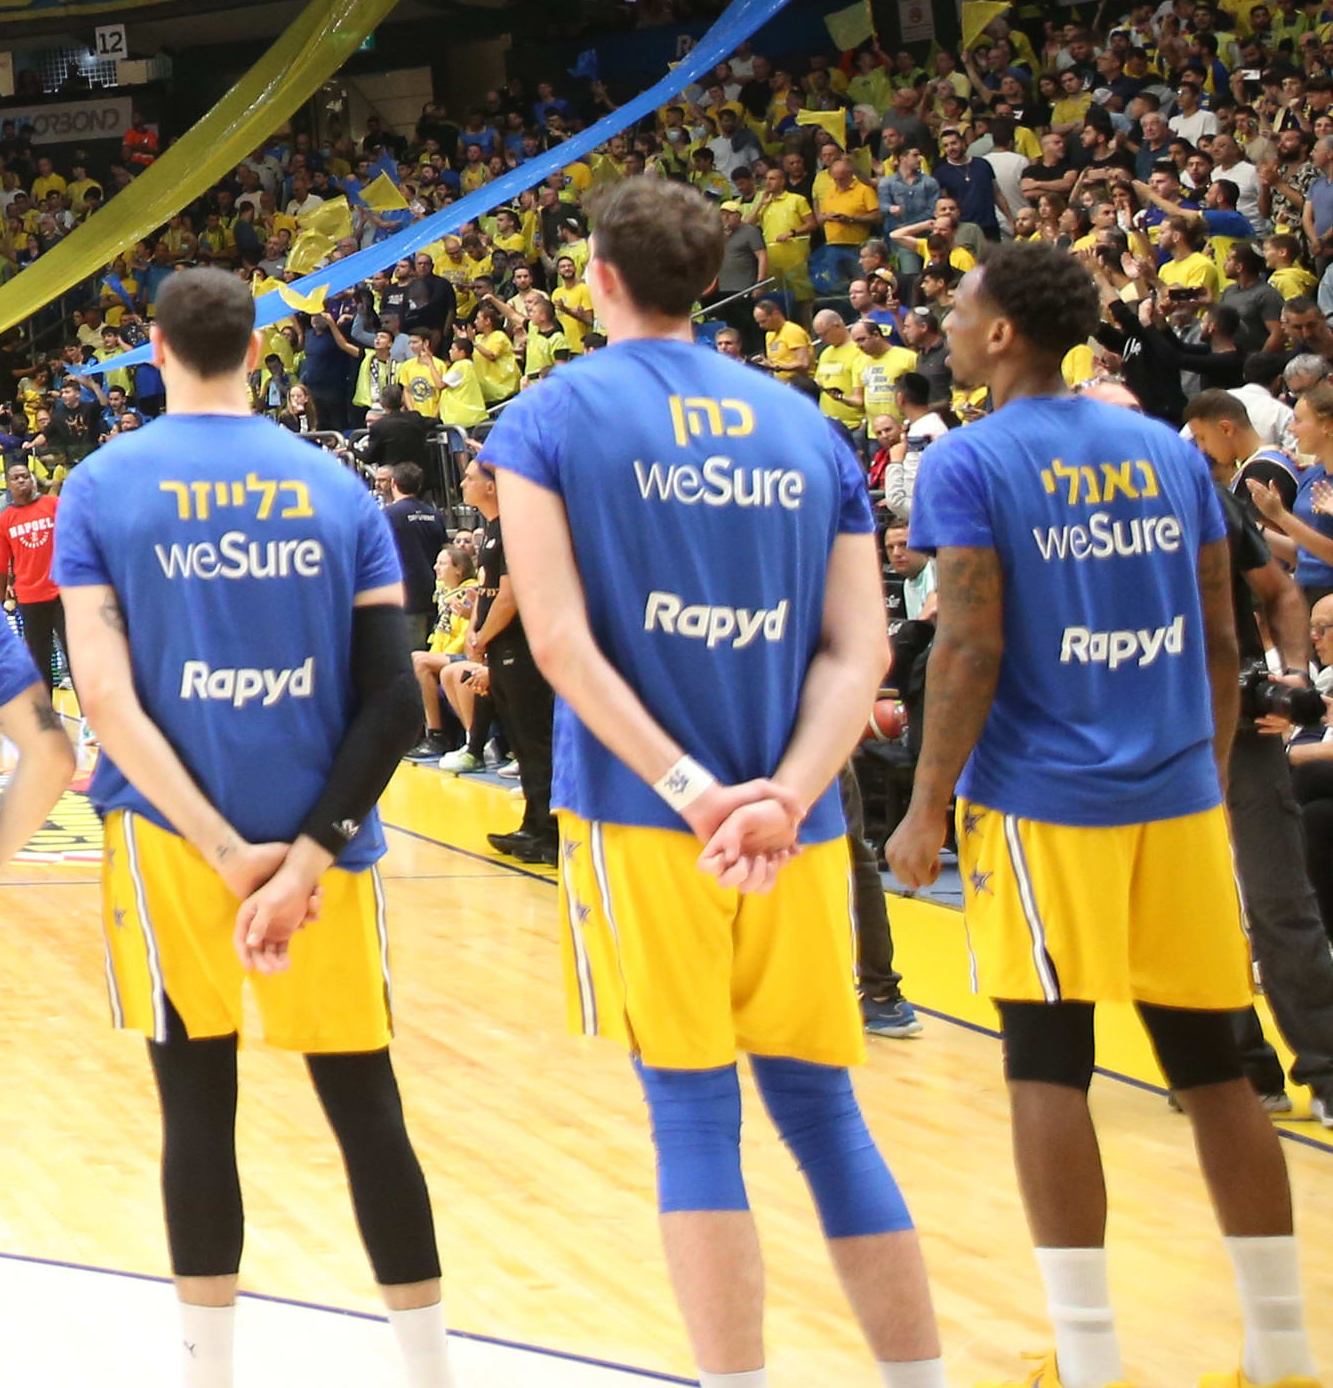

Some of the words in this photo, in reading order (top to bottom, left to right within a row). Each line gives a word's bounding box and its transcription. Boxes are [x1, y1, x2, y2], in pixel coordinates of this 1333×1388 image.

[98, 30, 124, 55] 12
[33, 107, 119, 136] ORBOND
[669, 394, 755, 447] כהן
[159, 472, 315, 520] בלייזר
[633, 457, 804, 510] weSure
[1040, 457, 1159, 506] נאנלי
[7, 516, 55, 539] HAPOEL
[1033, 513, 1181, 562] weSure
[155, 530, 324, 579] weSure
[644, 592, 790, 649] Rapyd
[1059, 614, 1186, 669] Rapyd
[180, 657, 315, 707] Rapyd
